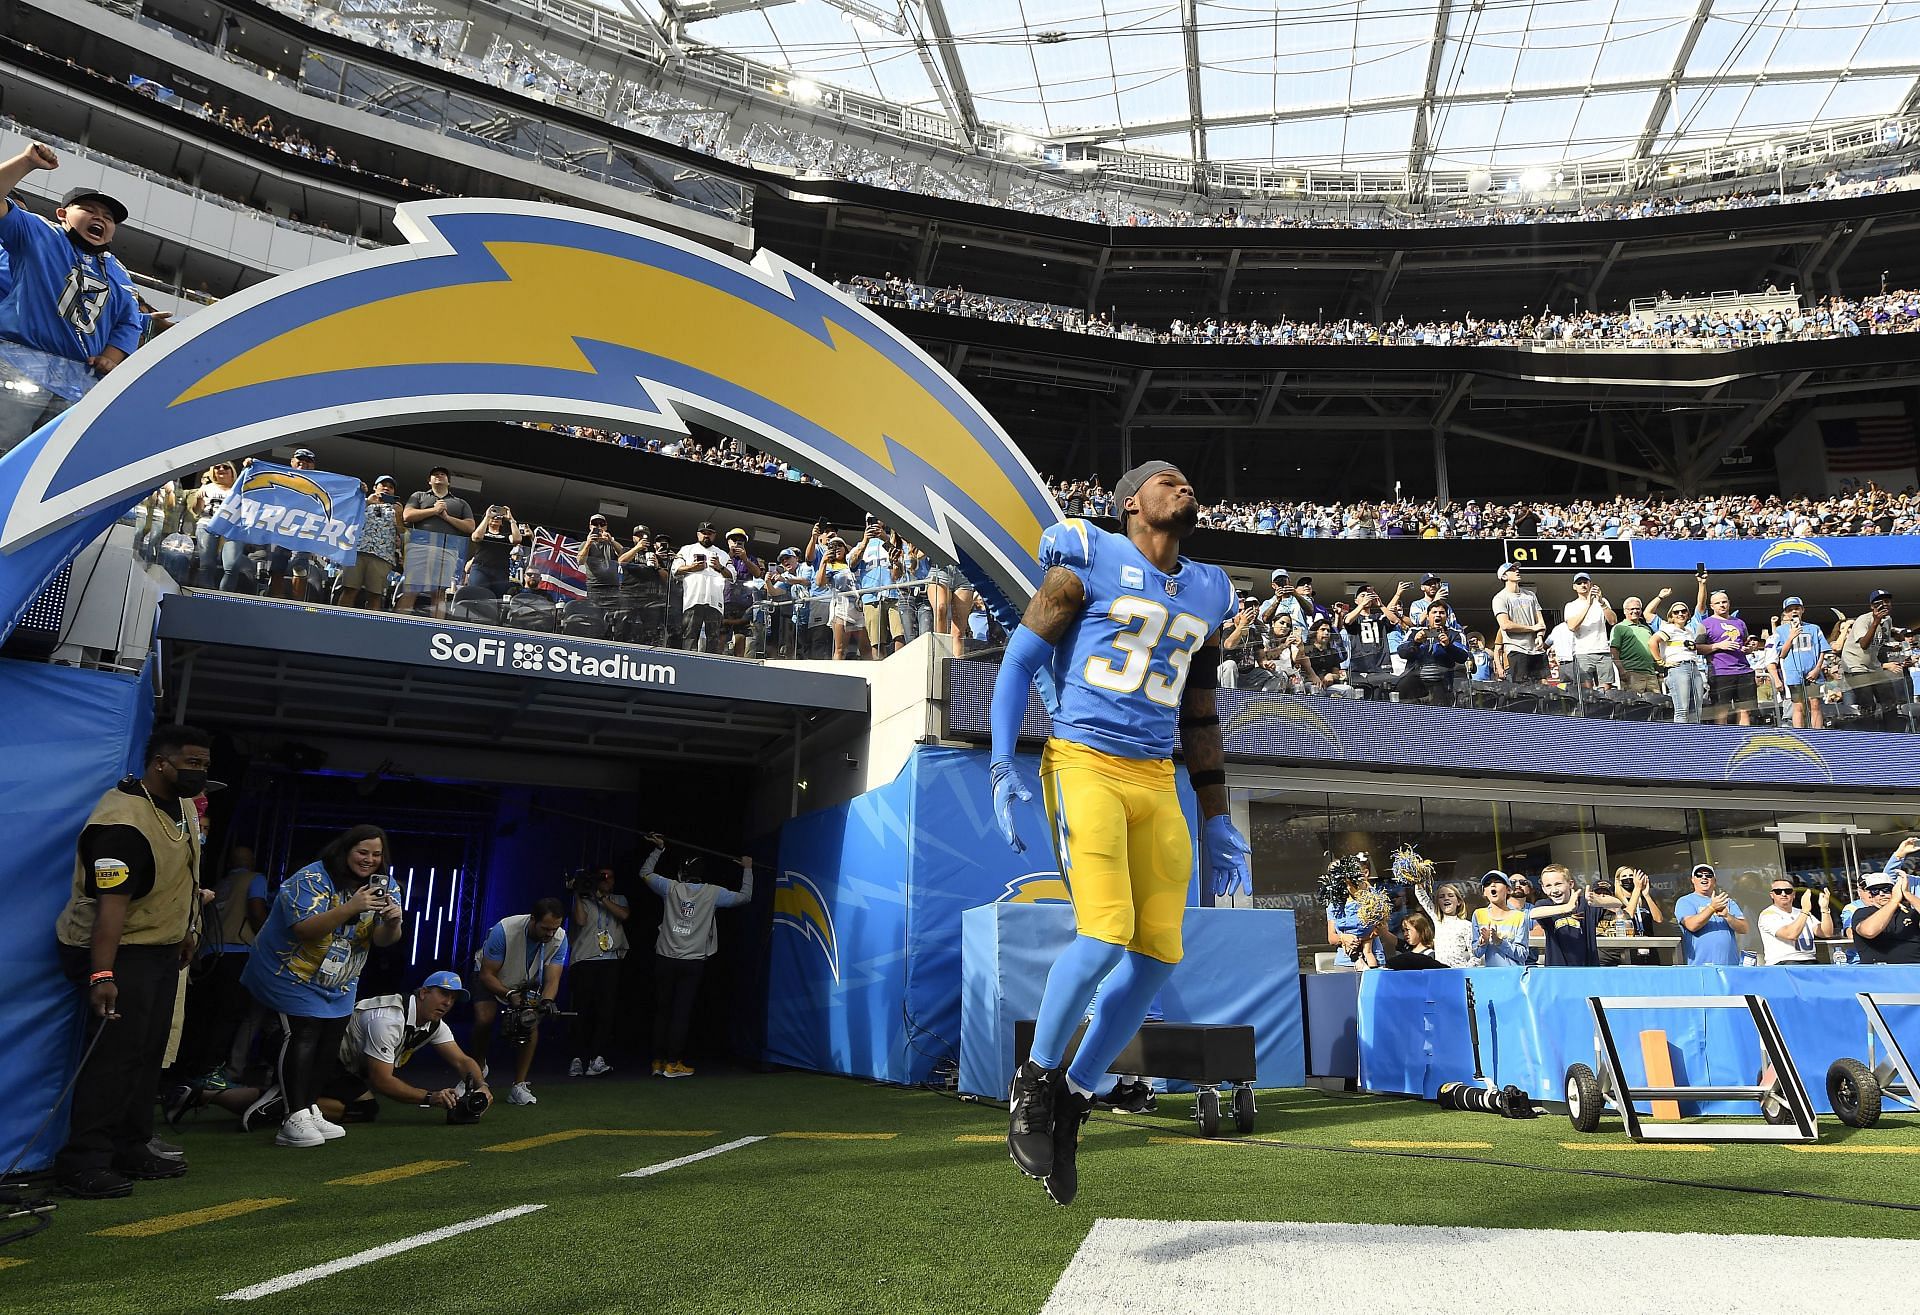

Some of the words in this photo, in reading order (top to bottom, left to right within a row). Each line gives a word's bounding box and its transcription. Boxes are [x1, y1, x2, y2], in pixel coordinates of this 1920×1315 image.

[58, 267, 109, 335] 13
[1513, 547, 1539, 561] Q1
[1552, 544, 1613, 564] 7:14
[1083, 595, 1209, 708] 33
[1360, 621, 1380, 644] 81
[429, 633, 506, 667] SoFi
[547, 646, 676, 685] Stadium
